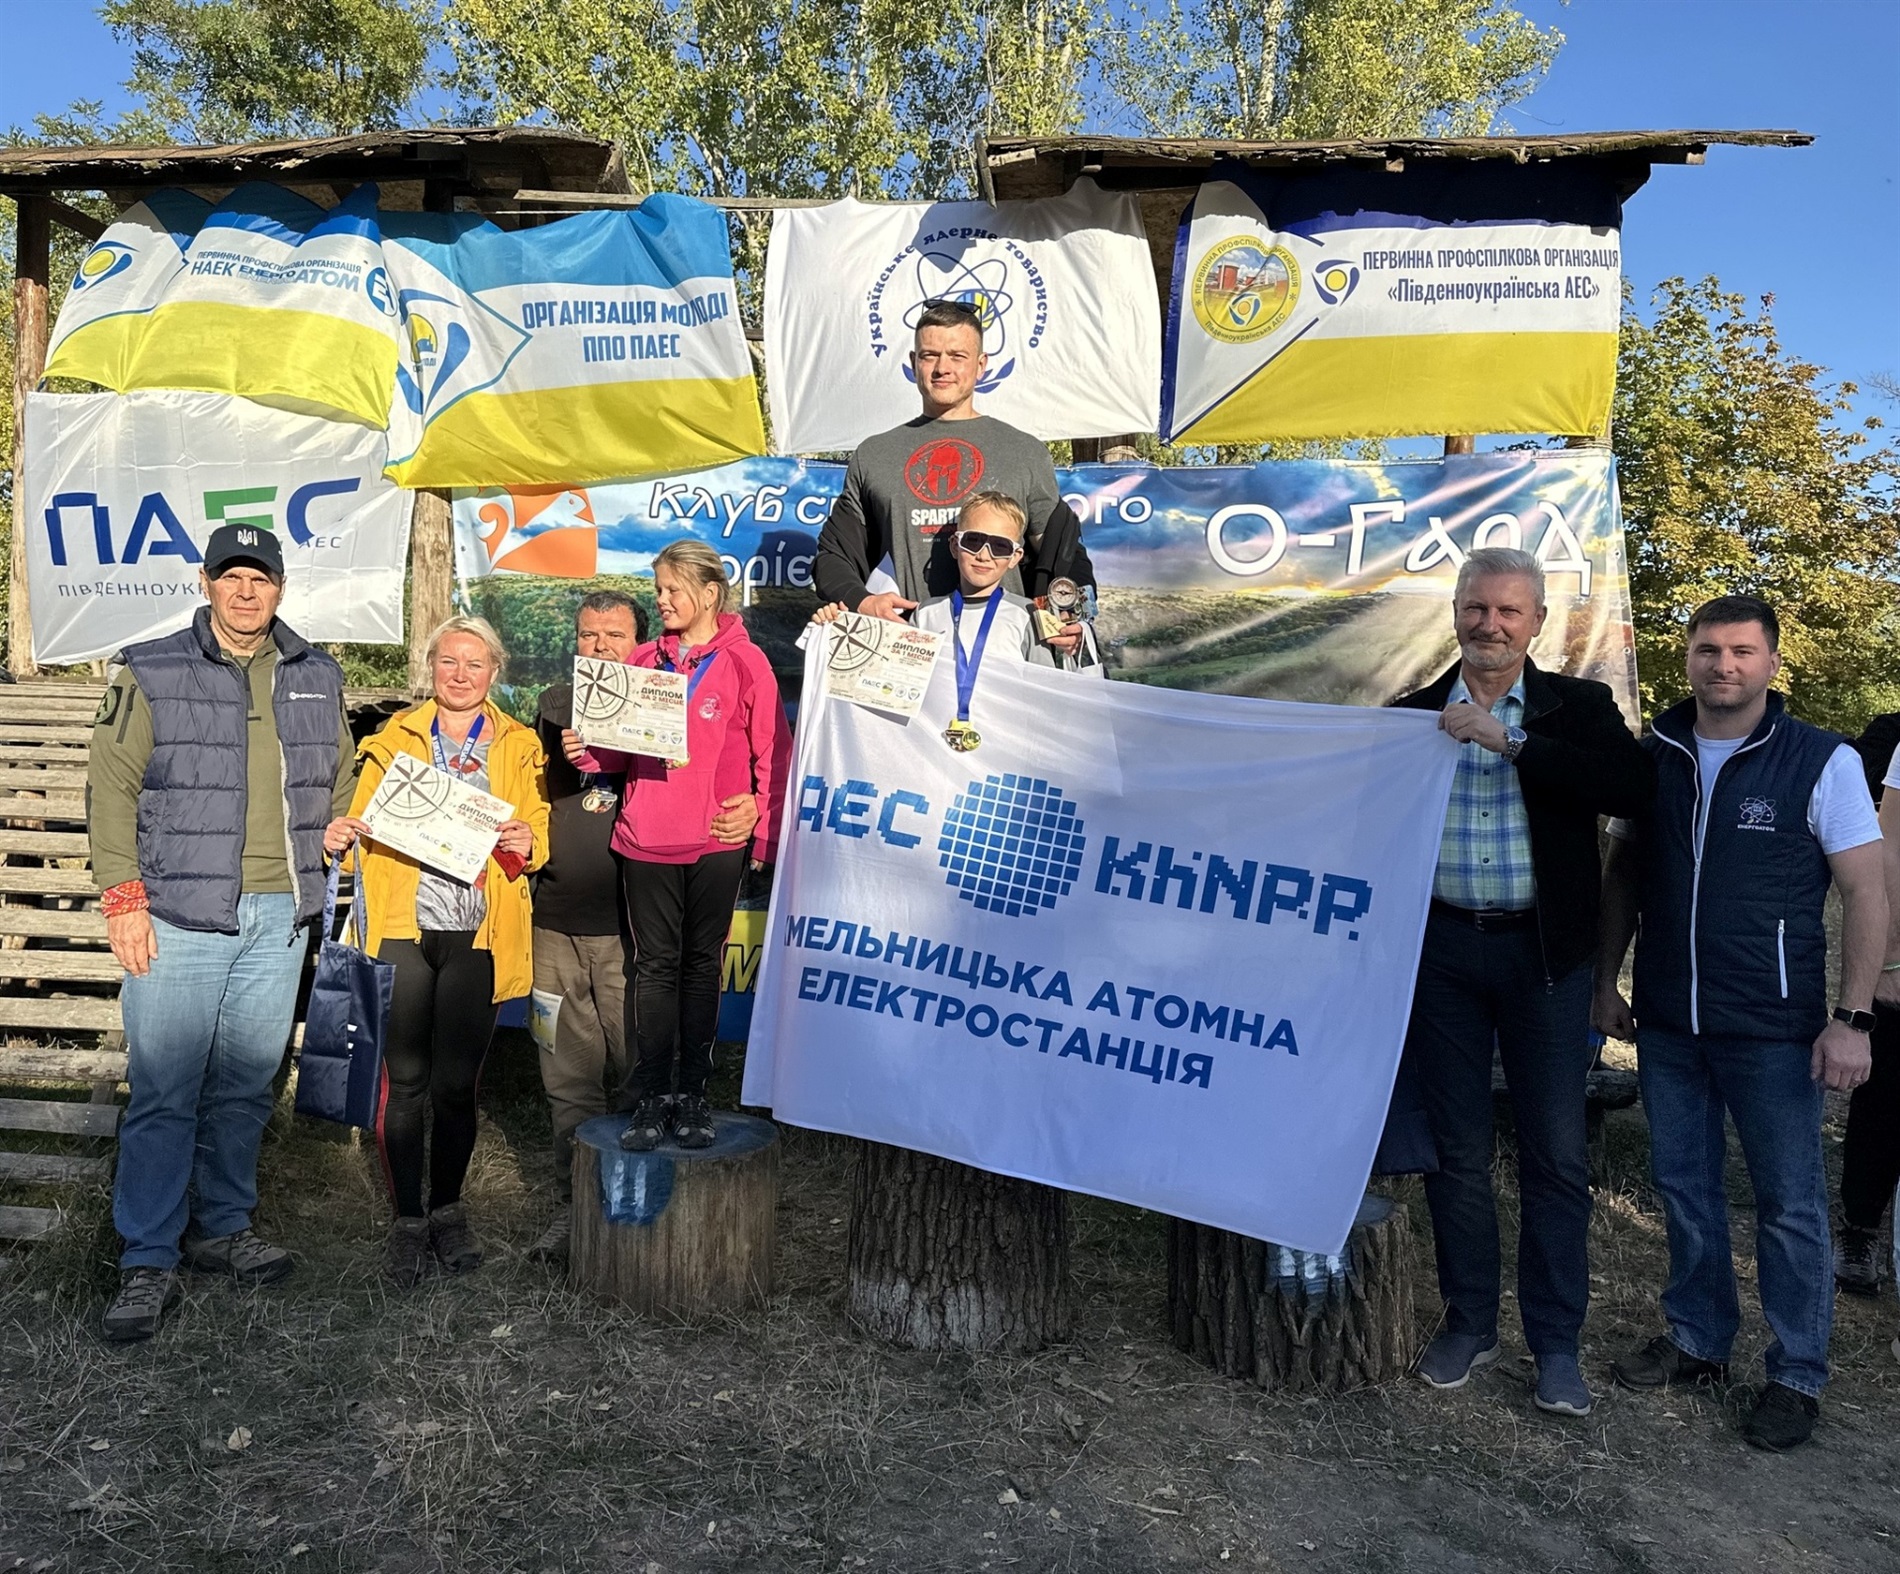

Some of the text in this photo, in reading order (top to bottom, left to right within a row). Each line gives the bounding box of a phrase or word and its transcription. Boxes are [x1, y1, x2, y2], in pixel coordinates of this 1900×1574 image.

[190, 261, 237, 276] НАЕК
[197, 251, 241, 262] ПЕРВИННА
[306, 259, 362, 274] ОРГАНІЗАЦІЯ
[1195, 252, 1219, 294] ПЕРВИННА
[1363, 248, 1618, 271] ПЕРВИННА ПРОФСПІЛКОВА ОРГАНІЗАЦІЯ
[867, 227, 1048, 358] Українське ядерне товариство
[1387, 277, 1600, 305] «Південноукраїнська АЕС»
[522, 300, 656, 330] ОРГАНІЗАЦІЯ
[583, 333, 681, 363] ППО ПАЕС
[649, 482, 788, 538] Клуб
[298, 536, 342, 549] АЕС
[892, 641, 935, 657] ДИПЛОМ
[641, 687, 683, 700] ДИПЛОМ
[784, 914, 1300, 1057] МЕЛЬНИЦЬКА АТОМНА
[798, 966, 1214, 1089] ЕЛЕКТРОСТАНЦІЯ
